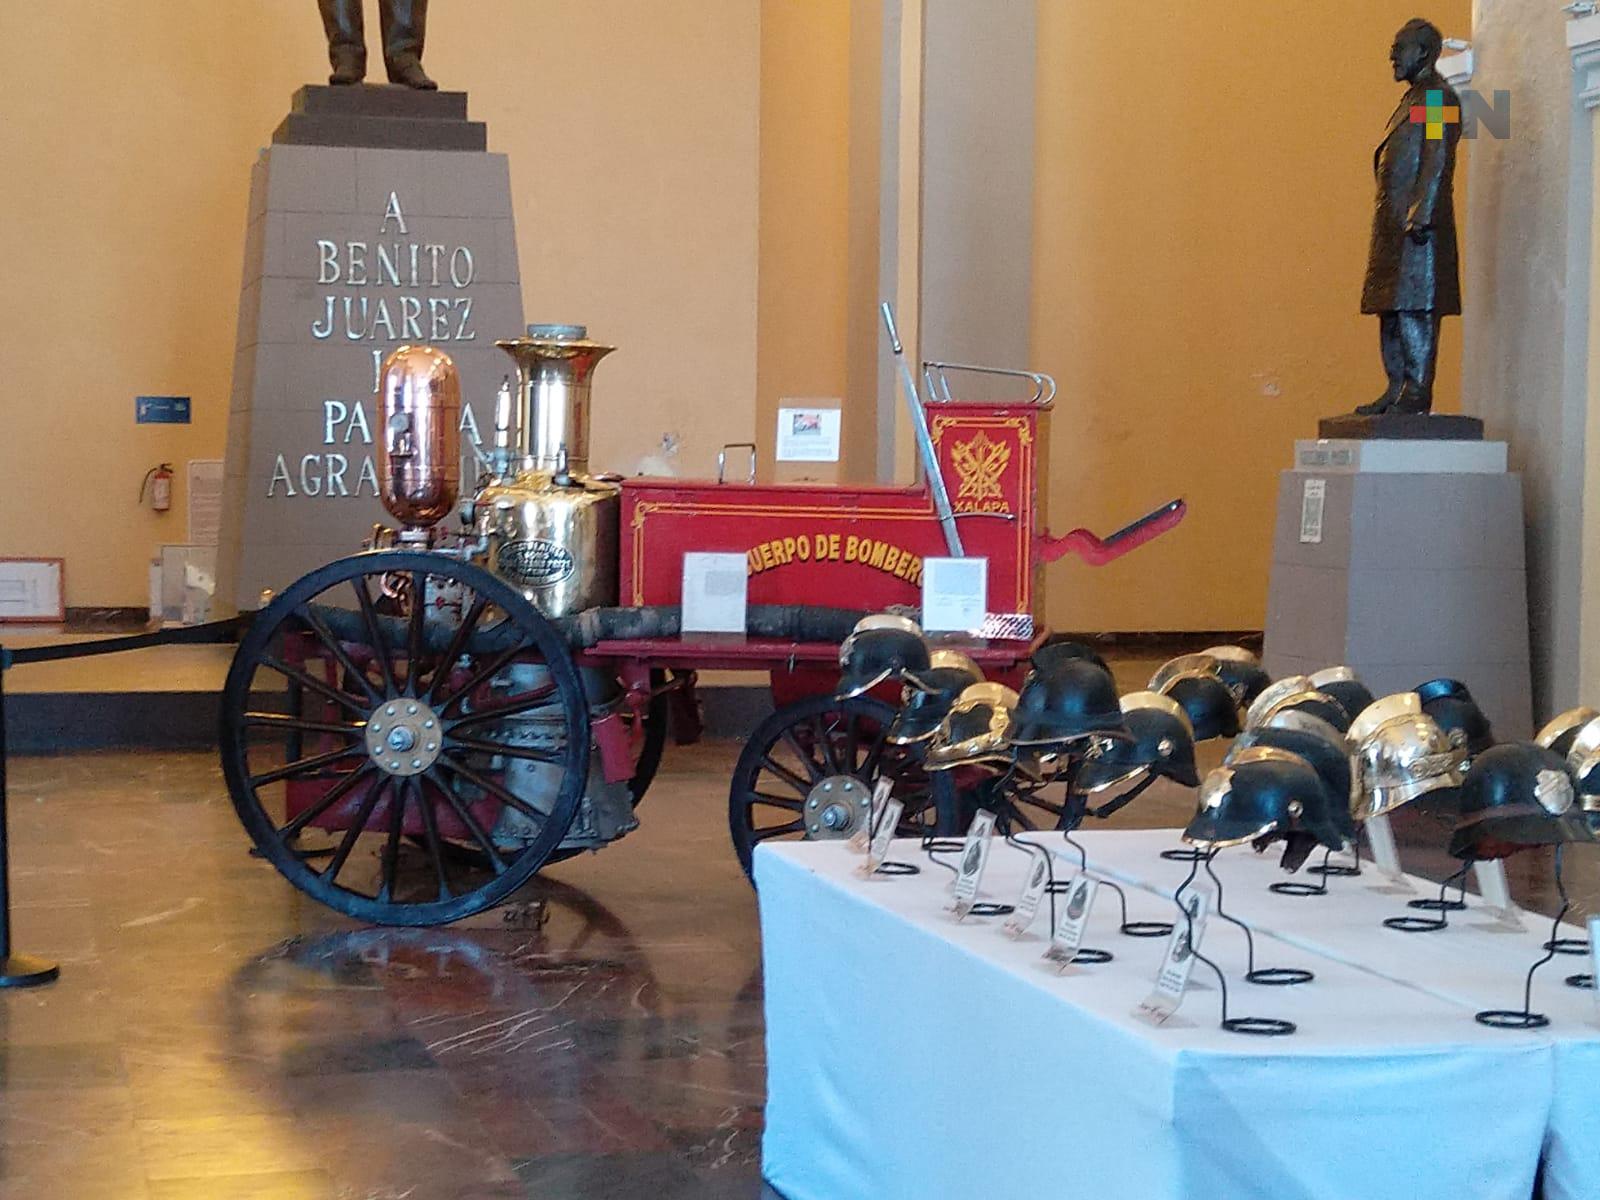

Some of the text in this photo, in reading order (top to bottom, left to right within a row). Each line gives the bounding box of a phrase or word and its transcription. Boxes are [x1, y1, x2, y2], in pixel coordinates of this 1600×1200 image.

[381, 191, 408, 234] A
[317, 240, 476, 288] BENITO
[312, 295, 477, 341] JUAREZ
[323, 400, 482, 444] PAA
[953, 500, 1010, 514] XALAPA
[815, 533, 841, 562] DE
[844, 536, 925, 588] BOMBER
